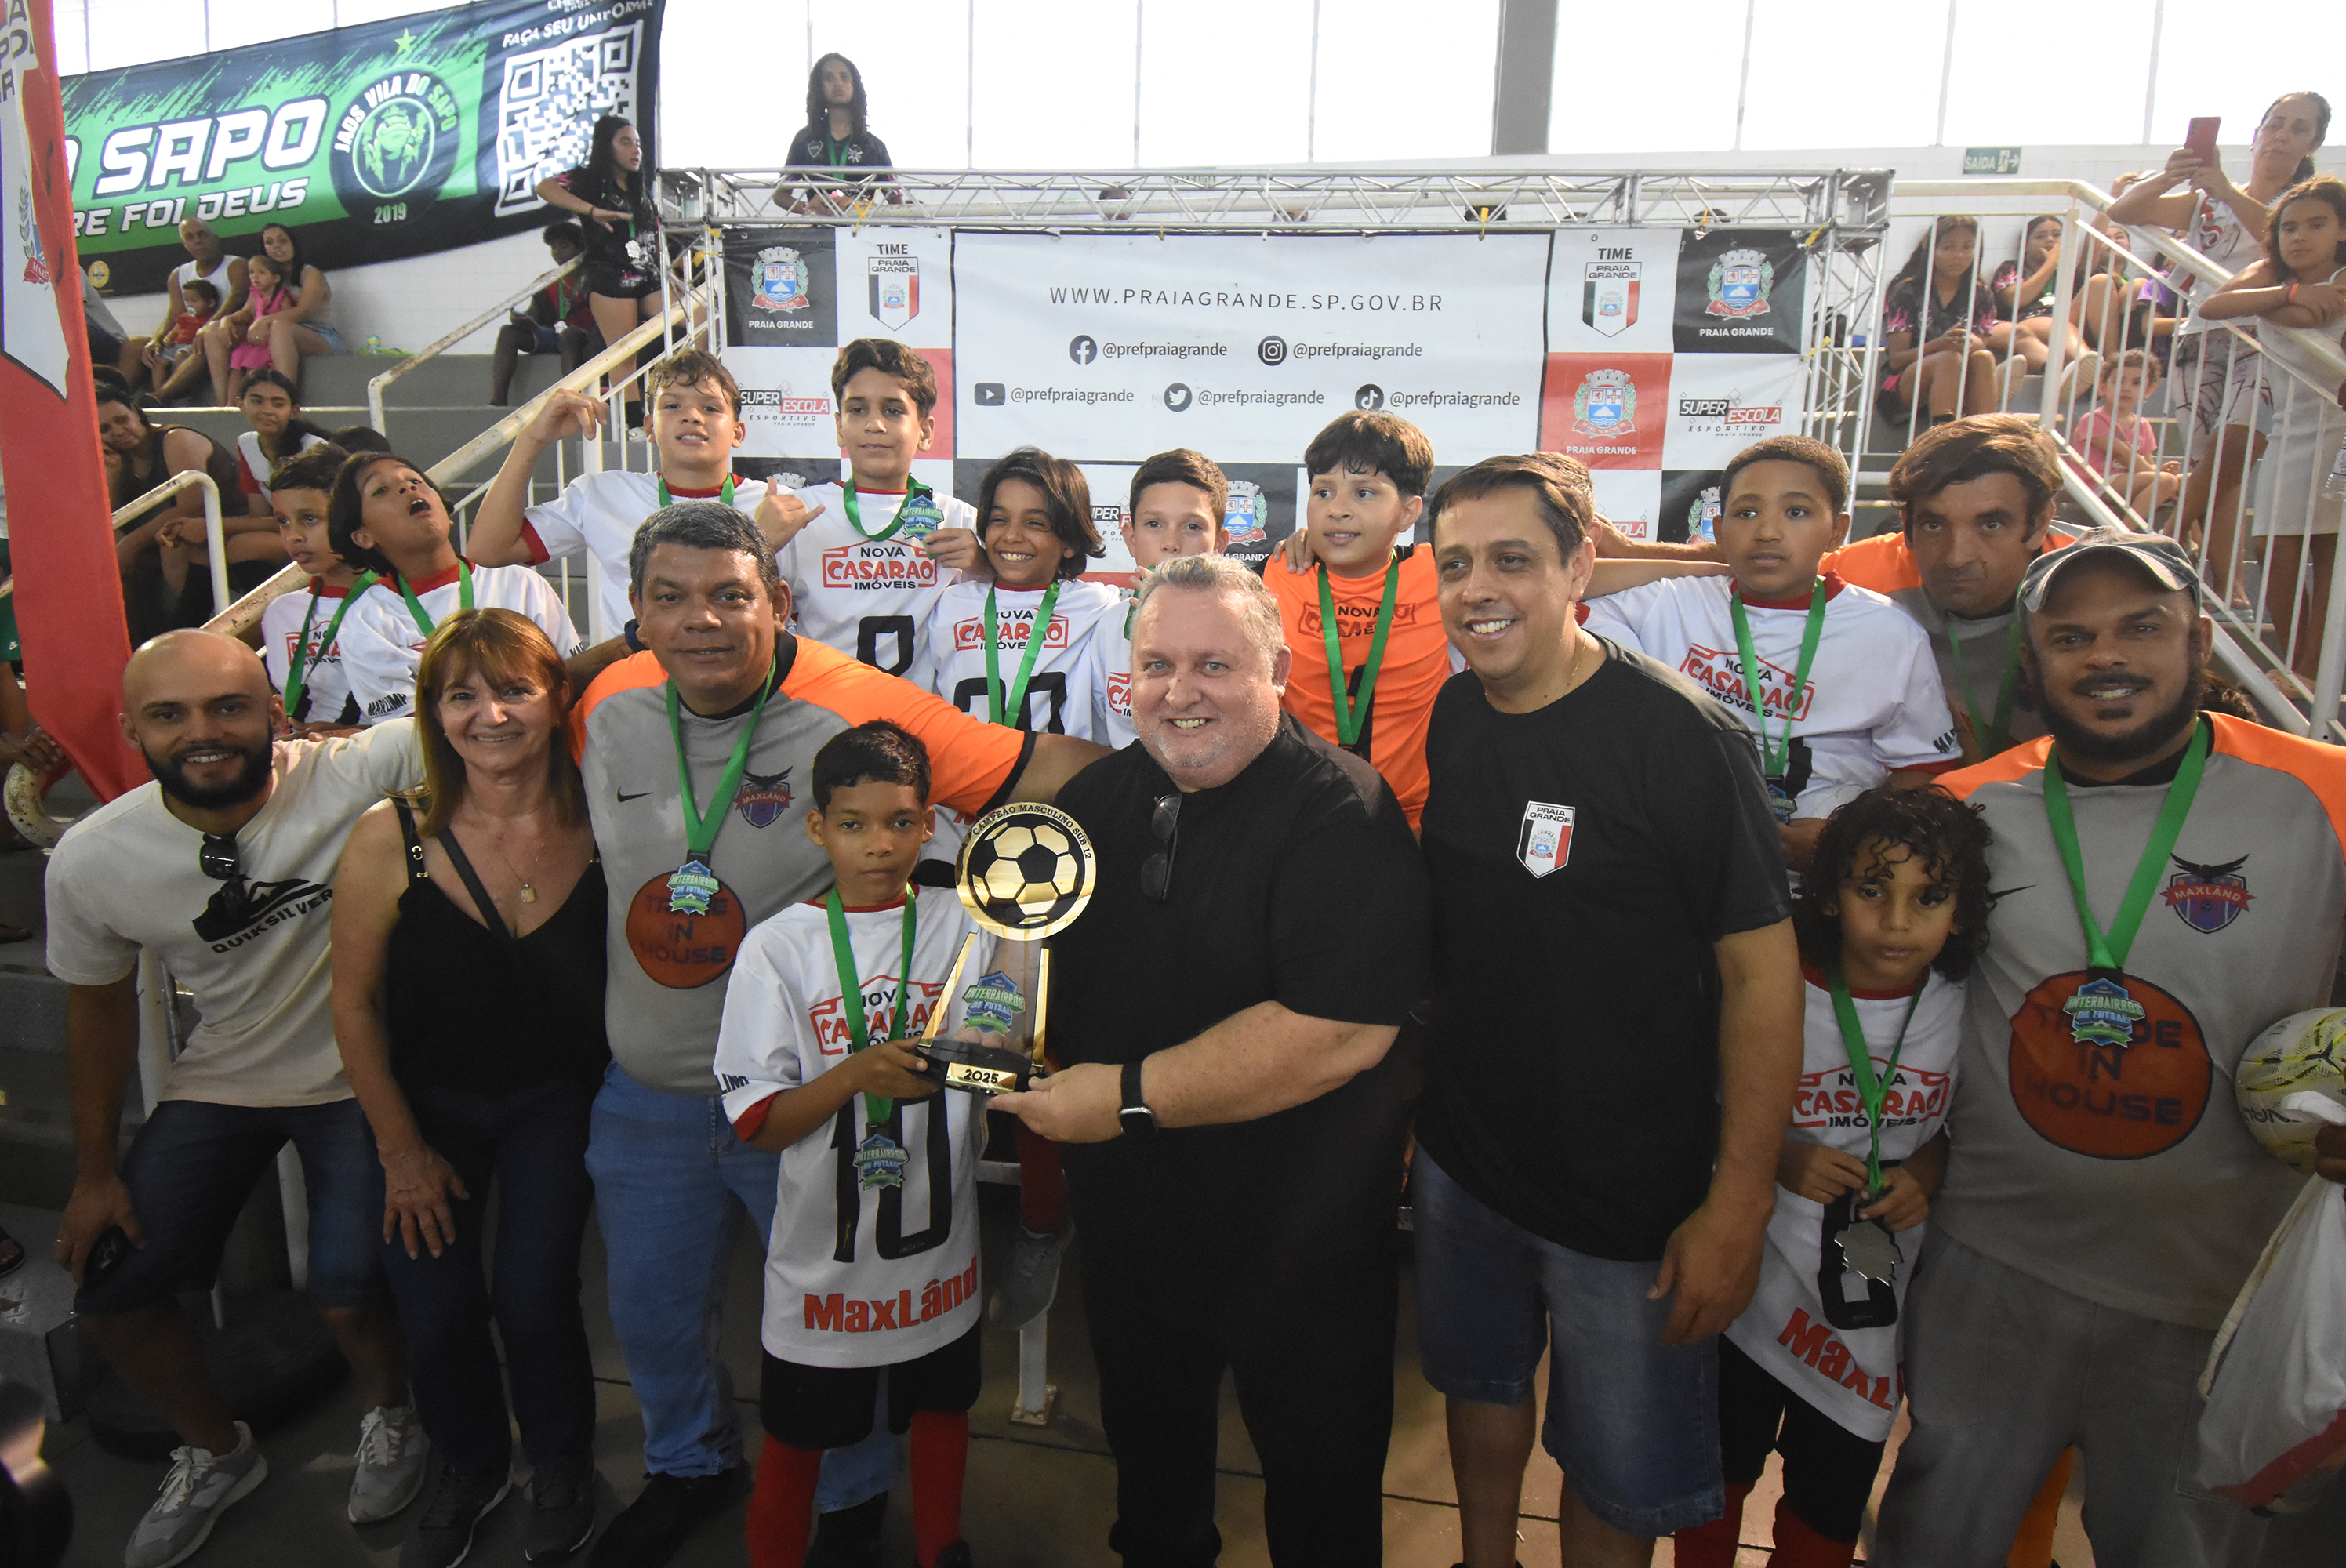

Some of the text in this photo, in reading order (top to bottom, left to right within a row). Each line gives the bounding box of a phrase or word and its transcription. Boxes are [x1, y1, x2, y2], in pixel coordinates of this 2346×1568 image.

[543, 17, 573, 38] SEU
[364, 75, 402, 109] VILA
[405, 73, 430, 96] DO
[427, 84, 457, 132] SAPO
[94, 97, 329, 196] SAPO
[1963, 151, 1996, 170] SAÍDA
[121, 197, 187, 233] FOI
[195, 177, 310, 221] DEUS
[373, 202, 408, 224] 2019
[877, 244, 908, 255] TIME
[1598, 247, 1633, 260] TIME
[1050, 286, 1442, 312] WWW.PRAIAGRANDE.SP.GOV.BR
[748, 320, 814, 328] PRAIA GRANDE
[1699, 327, 1774, 337] PRAIA GRANDE
[1102, 342, 1228, 359] @prefpraiagrande
[1293, 343, 1423, 360] @prefpraiagrande
[740, 391, 829, 412] SUPER ESCOLA
[1011, 387, 1135, 405] @prefpraiagrande
[1198, 390, 1325, 406] @prefpraiagrande
[1389, 390, 1520, 408] @prefpraiagrande
[1680, 401, 1780, 423] SUPER ESCOLA
[1567, 445, 1637, 455] PRAIA GRANDE
[860, 546, 906, 558] NOVA
[827, 560, 934, 580] CASARAO
[855, 579, 916, 590] IMÓVEIS
[1530, 812, 1571, 823] GRANDE
[1537, 807, 1566, 816] PRAIA
[972, 804, 1092, 859] CAMPEÃO MASCULINO SUB 12
[964, 987, 1024, 1010] INTERBAIRROS
[2065, 996, 2144, 1018] INTERBAIRROS
[971, 1000, 1011, 1015] DE FUTSAL
[2076, 1010, 2129, 1023] DE FUTSAL
[964, 1069, 999, 1084] 2025
